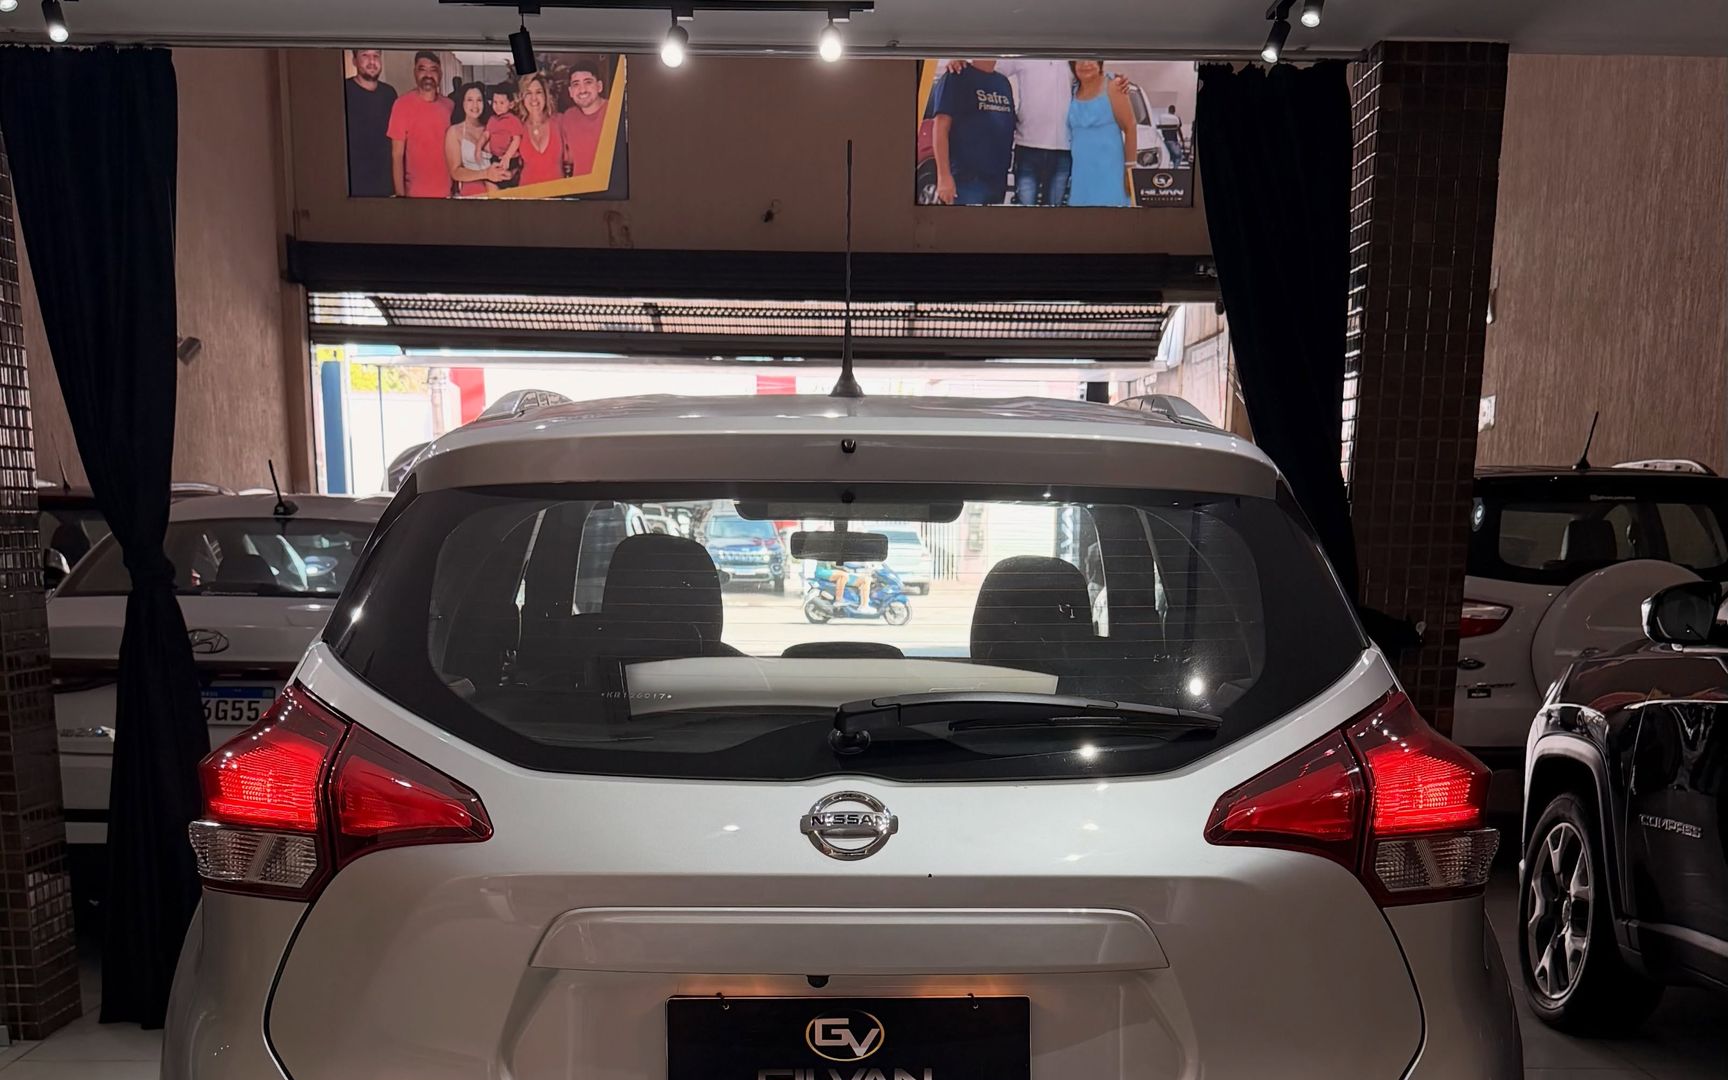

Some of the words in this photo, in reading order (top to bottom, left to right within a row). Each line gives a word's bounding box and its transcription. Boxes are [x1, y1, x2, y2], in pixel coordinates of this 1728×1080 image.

[976, 89, 1010, 105] Safra
[811, 814, 887, 827] NISSAN
[1639, 813, 1702, 839] COMPASS
[814, 1018, 881, 1057] GV
